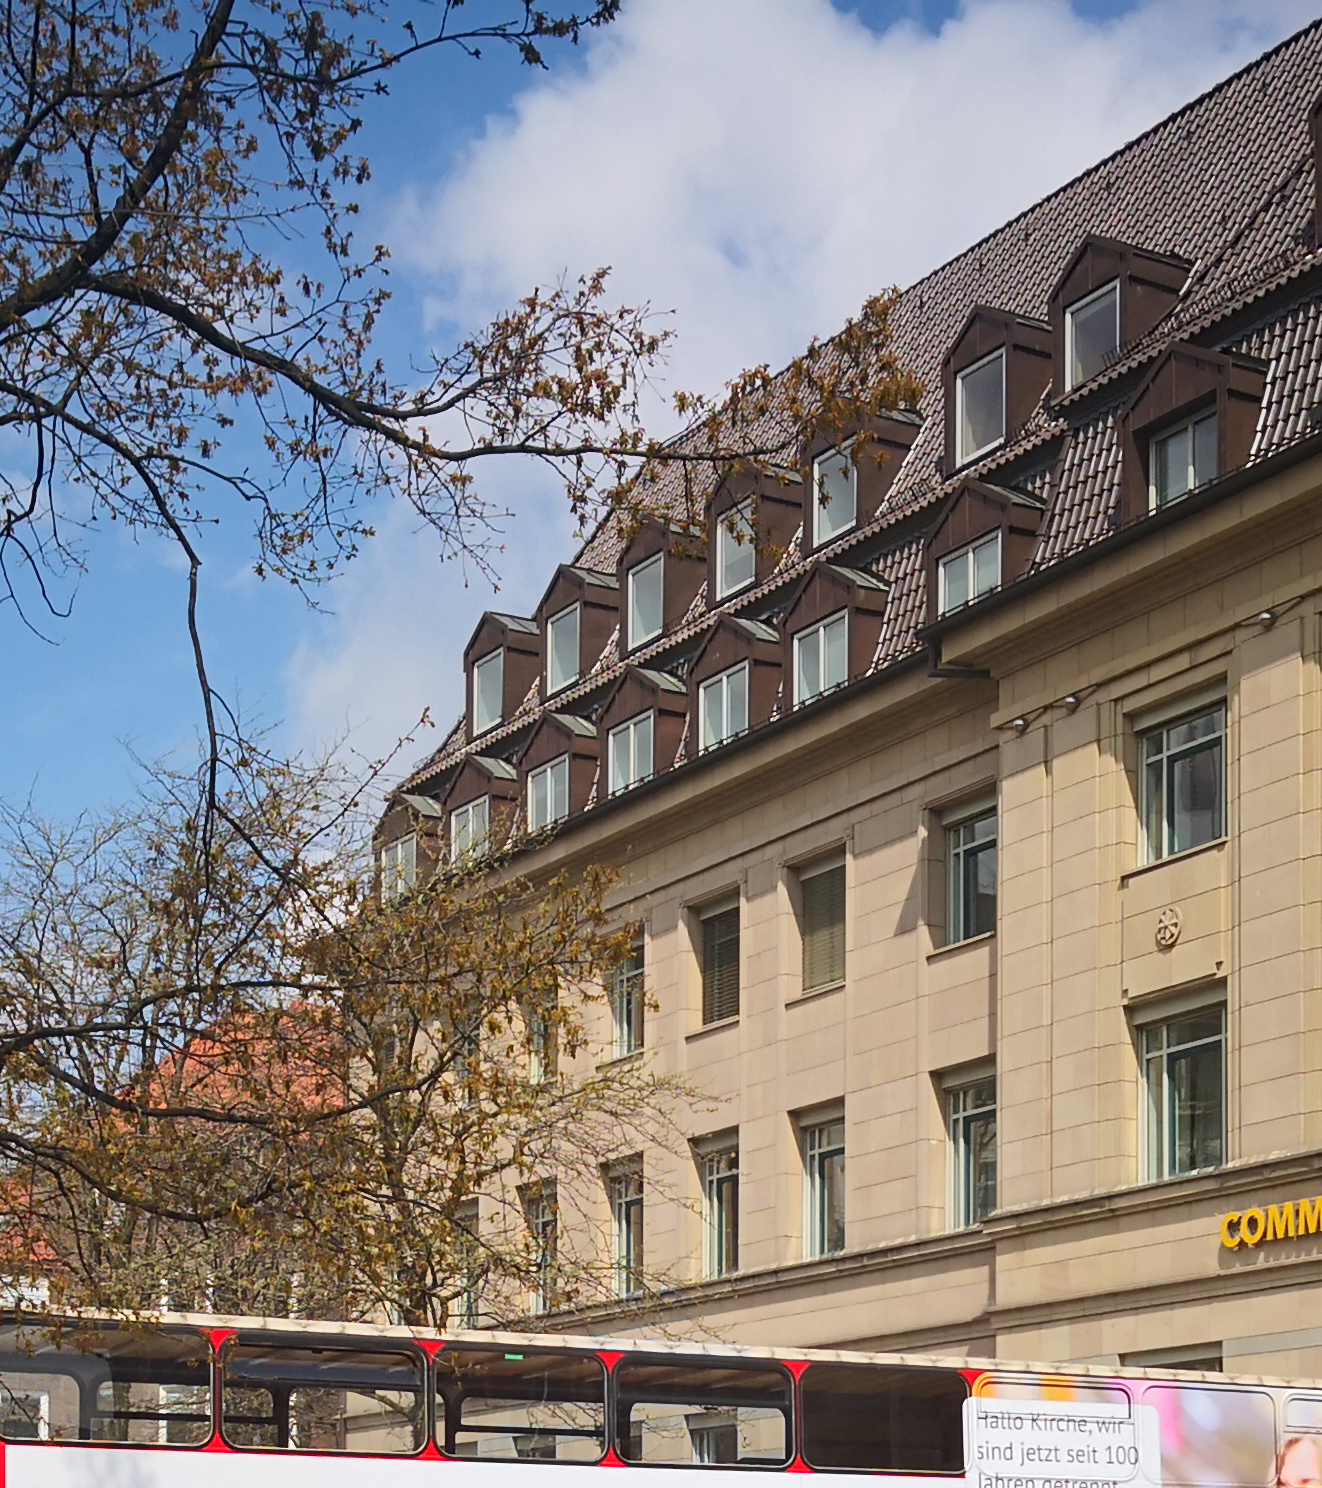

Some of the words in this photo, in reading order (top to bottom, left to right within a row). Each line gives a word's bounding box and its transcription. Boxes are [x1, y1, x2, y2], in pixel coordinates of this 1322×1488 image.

[977, 1411, 1023, 1430] Hallo
[1031, 1413, 1092, 1436] Kirche,
[1096, 1416, 1124, 1434] wir
[977, 1441, 1013, 1461] sind
[1020, 1443, 1061, 1466] jetzt
[1067, 1445, 1098, 1463] seit
[1105, 1446, 1139, 1465] 100
